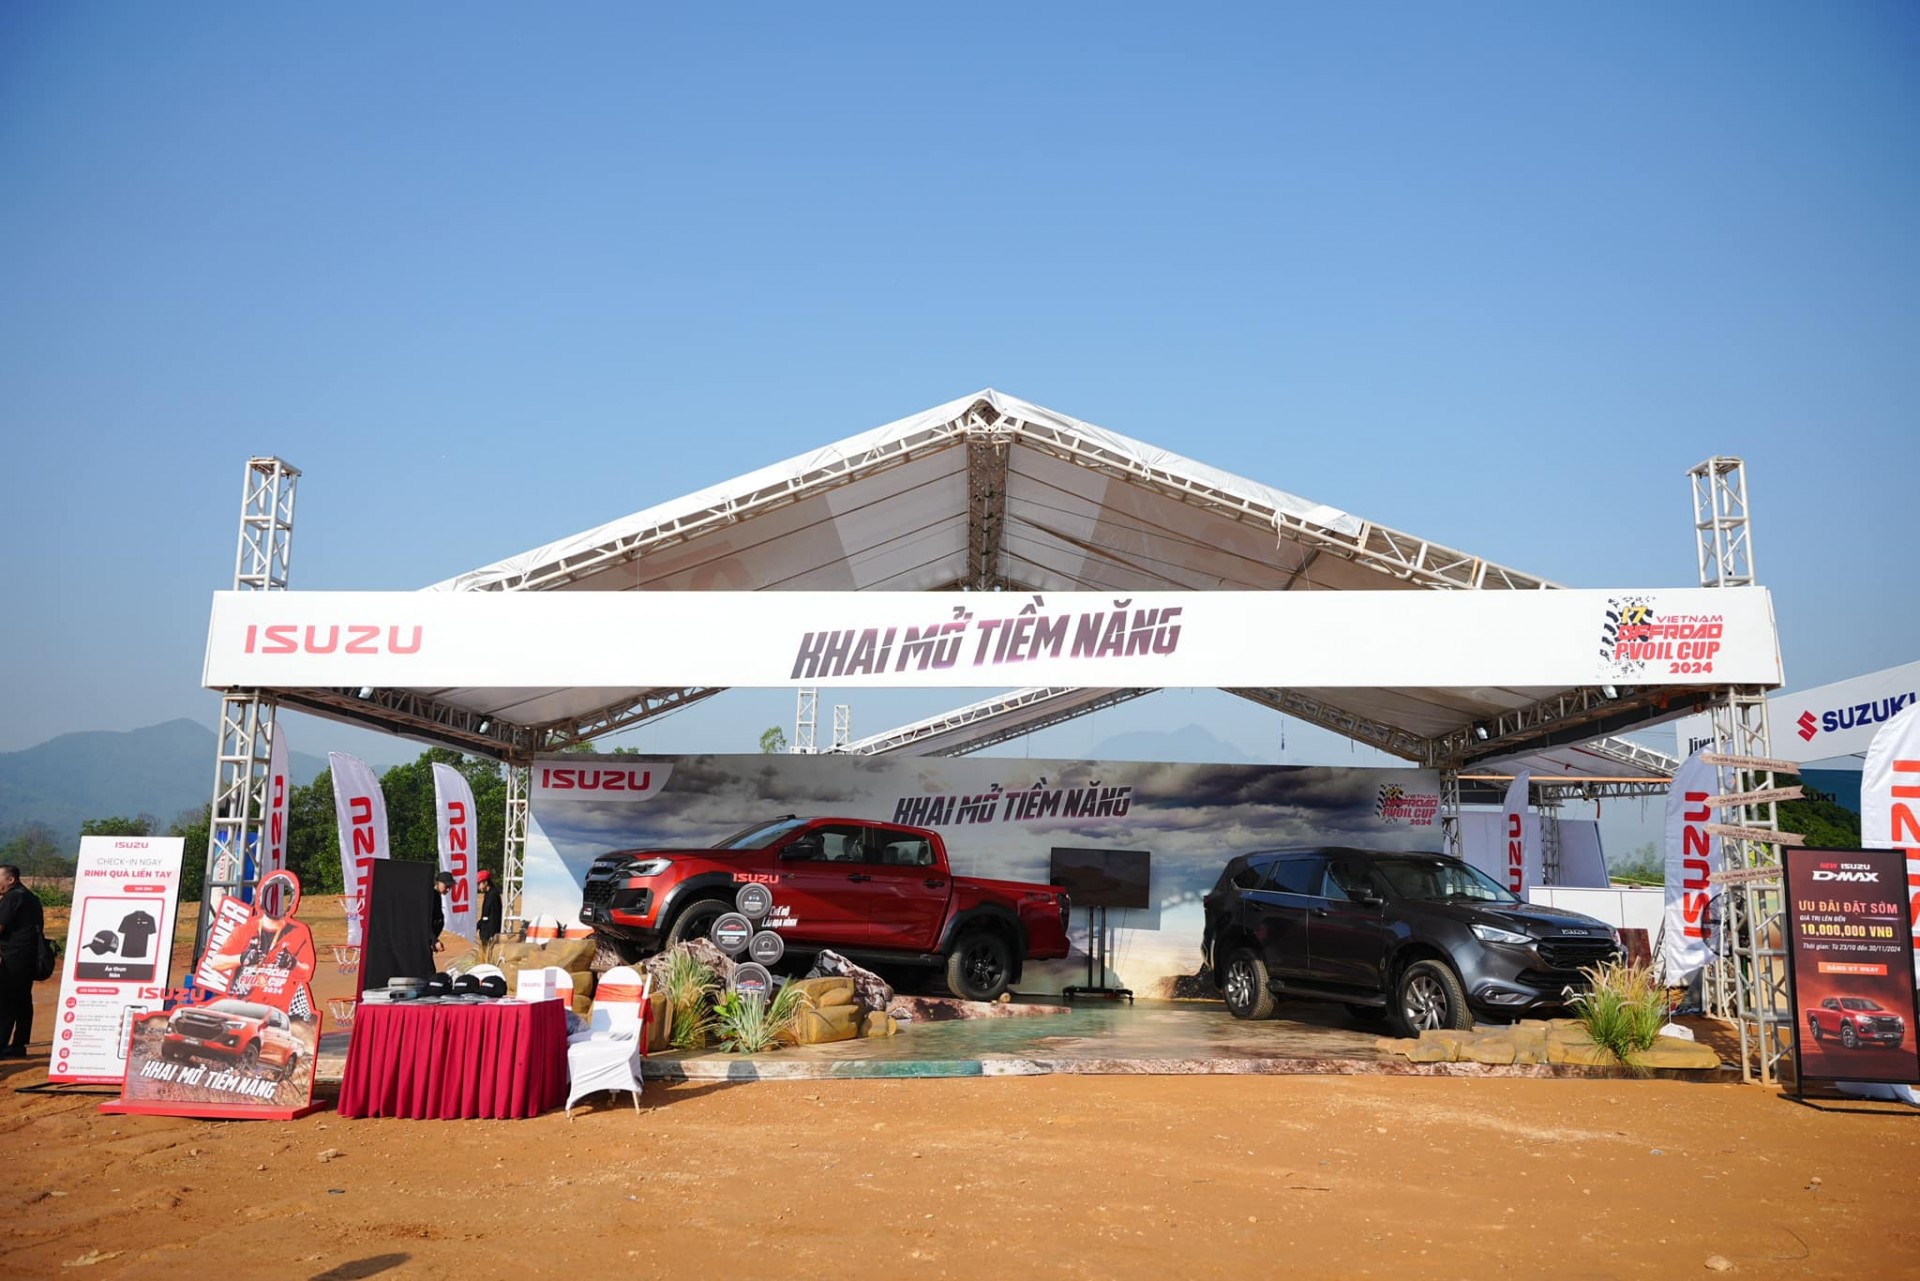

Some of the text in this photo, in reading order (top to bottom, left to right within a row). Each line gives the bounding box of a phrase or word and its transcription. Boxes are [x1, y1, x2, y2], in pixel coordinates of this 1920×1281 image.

[1656, 615, 1723, 623] VIETNAM
[244, 625, 422, 654] ISUZU
[790, 595, 1182, 679] KHAI MỞ TIỀM NĂNG
[1618, 624, 1723, 639] OFFROAD
[1615, 642, 1721, 660] PVOIL CUP
[1669, 662, 1713, 674] 2024
[1689, 736, 1725, 757] Jim
[542, 769, 650, 790] ISUZU
[892, 777, 1132, 826] KHAI MỞ TIỀM NĂNG
[1414, 808, 1436, 818] CUP
[448, 802, 469, 913] ISUZU
[1509, 813, 1522, 892] UZU
[97, 858, 163, 866] CHECK-IN NGAY
[1683, 792, 1711, 938] ISUZU
[732, 873, 779, 884] ISUZU
[1812, 871, 1879, 882] D-MAX
[1819, 900, 1840, 912] ĐÃI
[1843, 900, 1867, 915] ĐẶT
[1870, 901, 1898, 914] SỚM
[1801, 923, 1893, 938] 10,000,000 VNĐ
[137, 987, 205, 1001] ISUZU
[140, 1060, 278, 1099] KHAI MỞ TIỀM NĂNG
